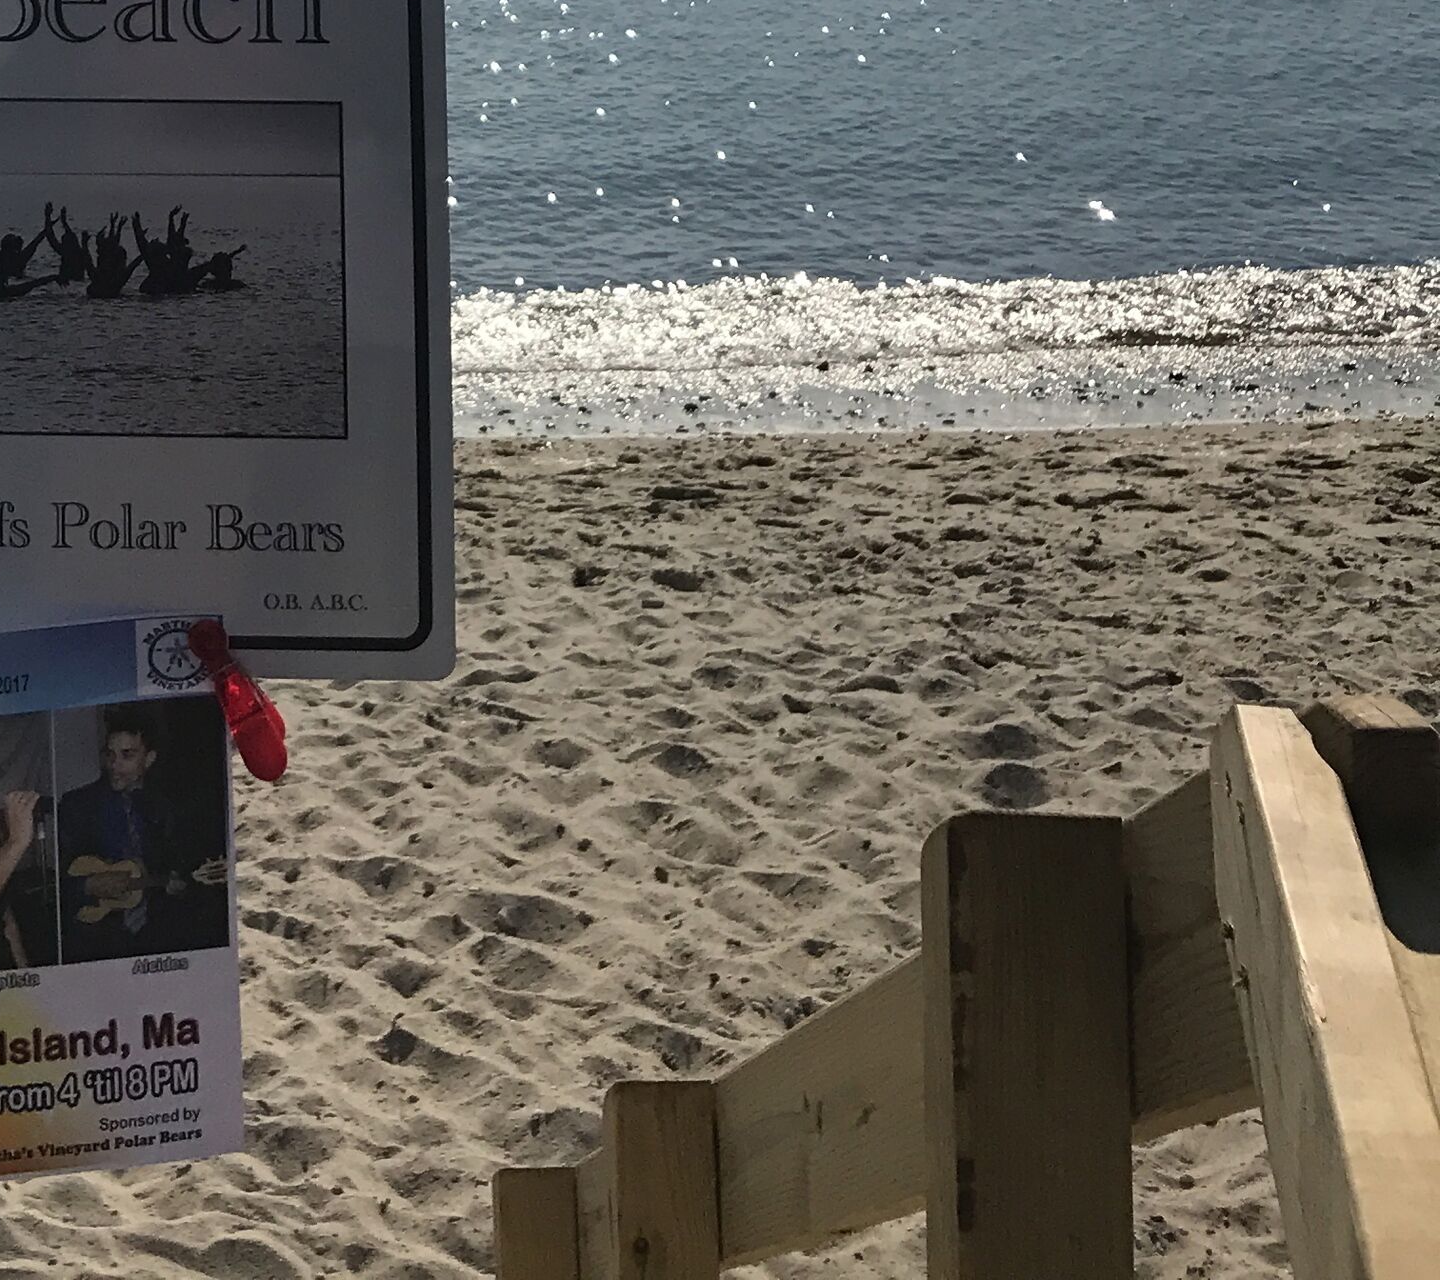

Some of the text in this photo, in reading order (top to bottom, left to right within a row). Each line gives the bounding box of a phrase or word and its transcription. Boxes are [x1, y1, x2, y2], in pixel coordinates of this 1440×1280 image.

[51, 502, 187, 550] Polar
[205, 504, 346, 552] Bears
[141, 1011, 201, 1050] Ma
[57, 1071, 81, 1108] 4
[125, 1064, 149, 1101] 8
[149, 1057, 199, 1098] PM
[98, 1106, 201, 1133] Sponsored by
